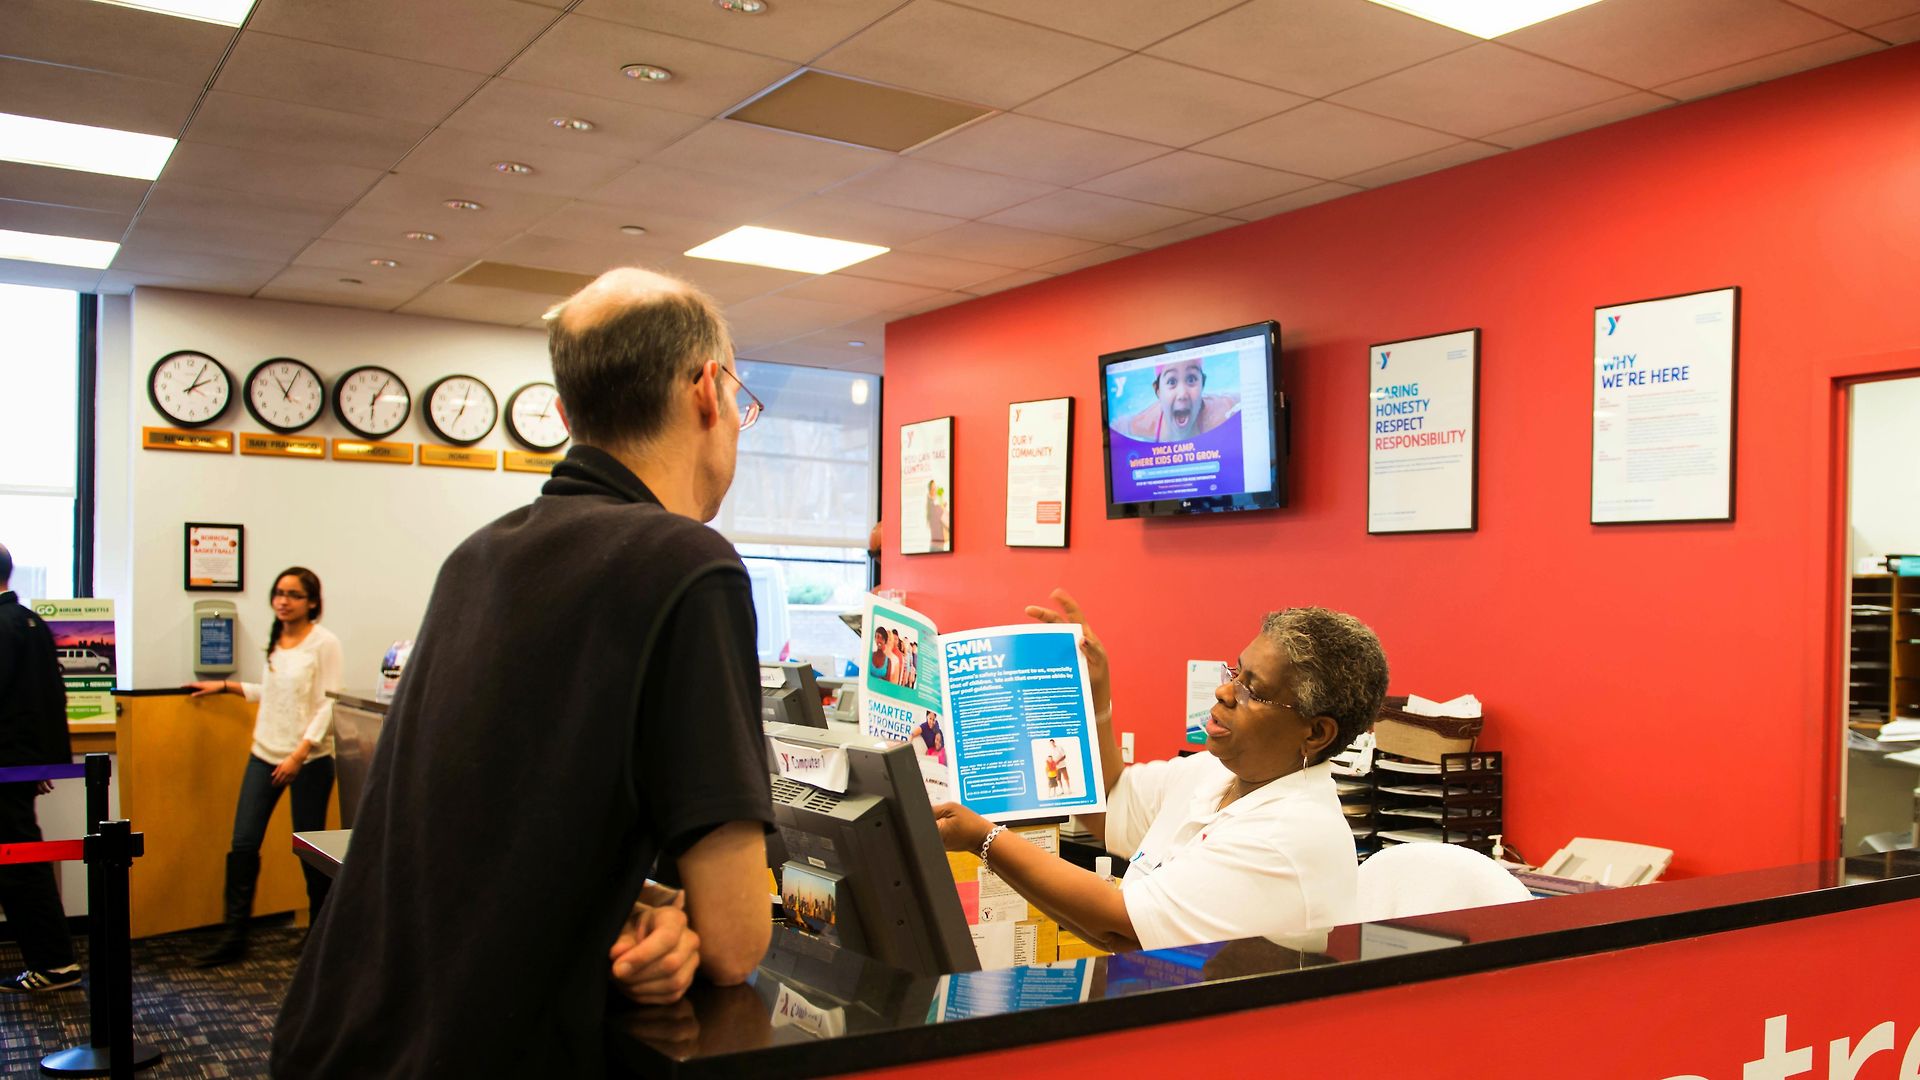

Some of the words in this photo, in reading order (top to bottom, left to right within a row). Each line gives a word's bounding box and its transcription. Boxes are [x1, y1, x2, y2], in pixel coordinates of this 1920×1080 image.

[1603, 353, 1637, 371] WHY
[1602, 370, 1646, 389] WE'RE
[1650, 365, 1690, 384] HERE
[1376, 382, 1419, 401] CARING
[1375, 398, 1431, 417] HONESTY
[1375, 416, 1424, 434] RESPECT
[164, 434, 184, 443] NEW
[189, 436, 212, 445] YORK
[248, 438, 267, 447] SAN
[1012, 435, 1027, 445] OUR
[1028, 434, 1033, 445] Y
[1375, 428, 1467, 451] RESPONSIBILITY
[448, 453, 470, 461] ROME
[1011, 446, 1053, 458] COMMUNITY
[1151, 445, 1173, 456] YMCA
[1173, 442, 1196, 453] CAMP.
[1129, 457, 1154, 468] WHERE
[1155, 454, 1172, 465] KIDS
[1173, 453, 1184, 463] GO
[1185, 452, 1195, 461] TO
[1196, 449, 1222, 460] GROW.
[37, 605, 55, 615] GO
[946, 638, 993, 658] SWIM
[948, 654, 1005, 674] SAFELY
[868, 699, 915, 724] SMARTER.
[868, 712, 912, 734] STRONGER
[791, 755, 820, 772] Computer
